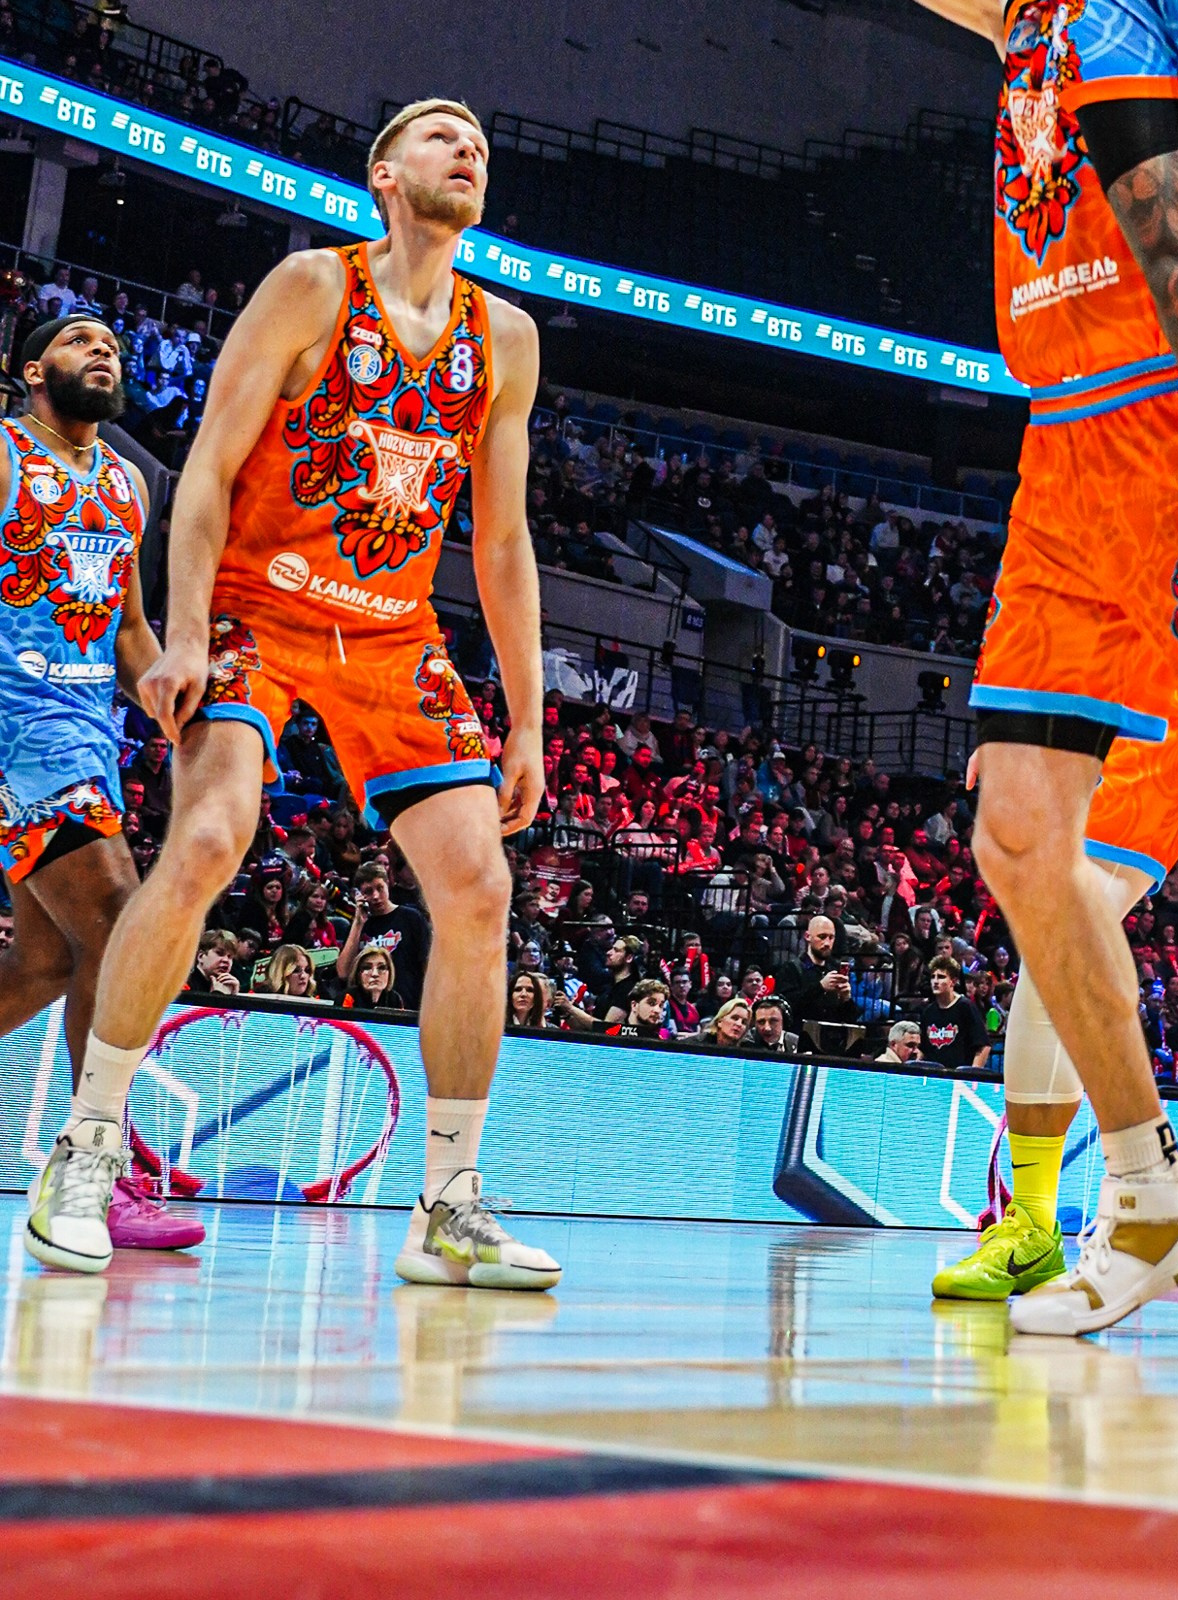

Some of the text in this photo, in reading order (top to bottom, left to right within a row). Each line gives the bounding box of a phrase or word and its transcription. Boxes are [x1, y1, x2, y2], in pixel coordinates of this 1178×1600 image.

[0, 76, 359, 222] ТБ ВТБ ВТБ ВТБ ВТБ ВТБ
[352, 326, 382, 345] ZEDO
[456, 238, 990, 383] ТБ ВТБ ВТБ ВТБ ВТБ ВТБ ВТБ ВТБ ВТБ
[71, 537, 113, 553] GOSTI
